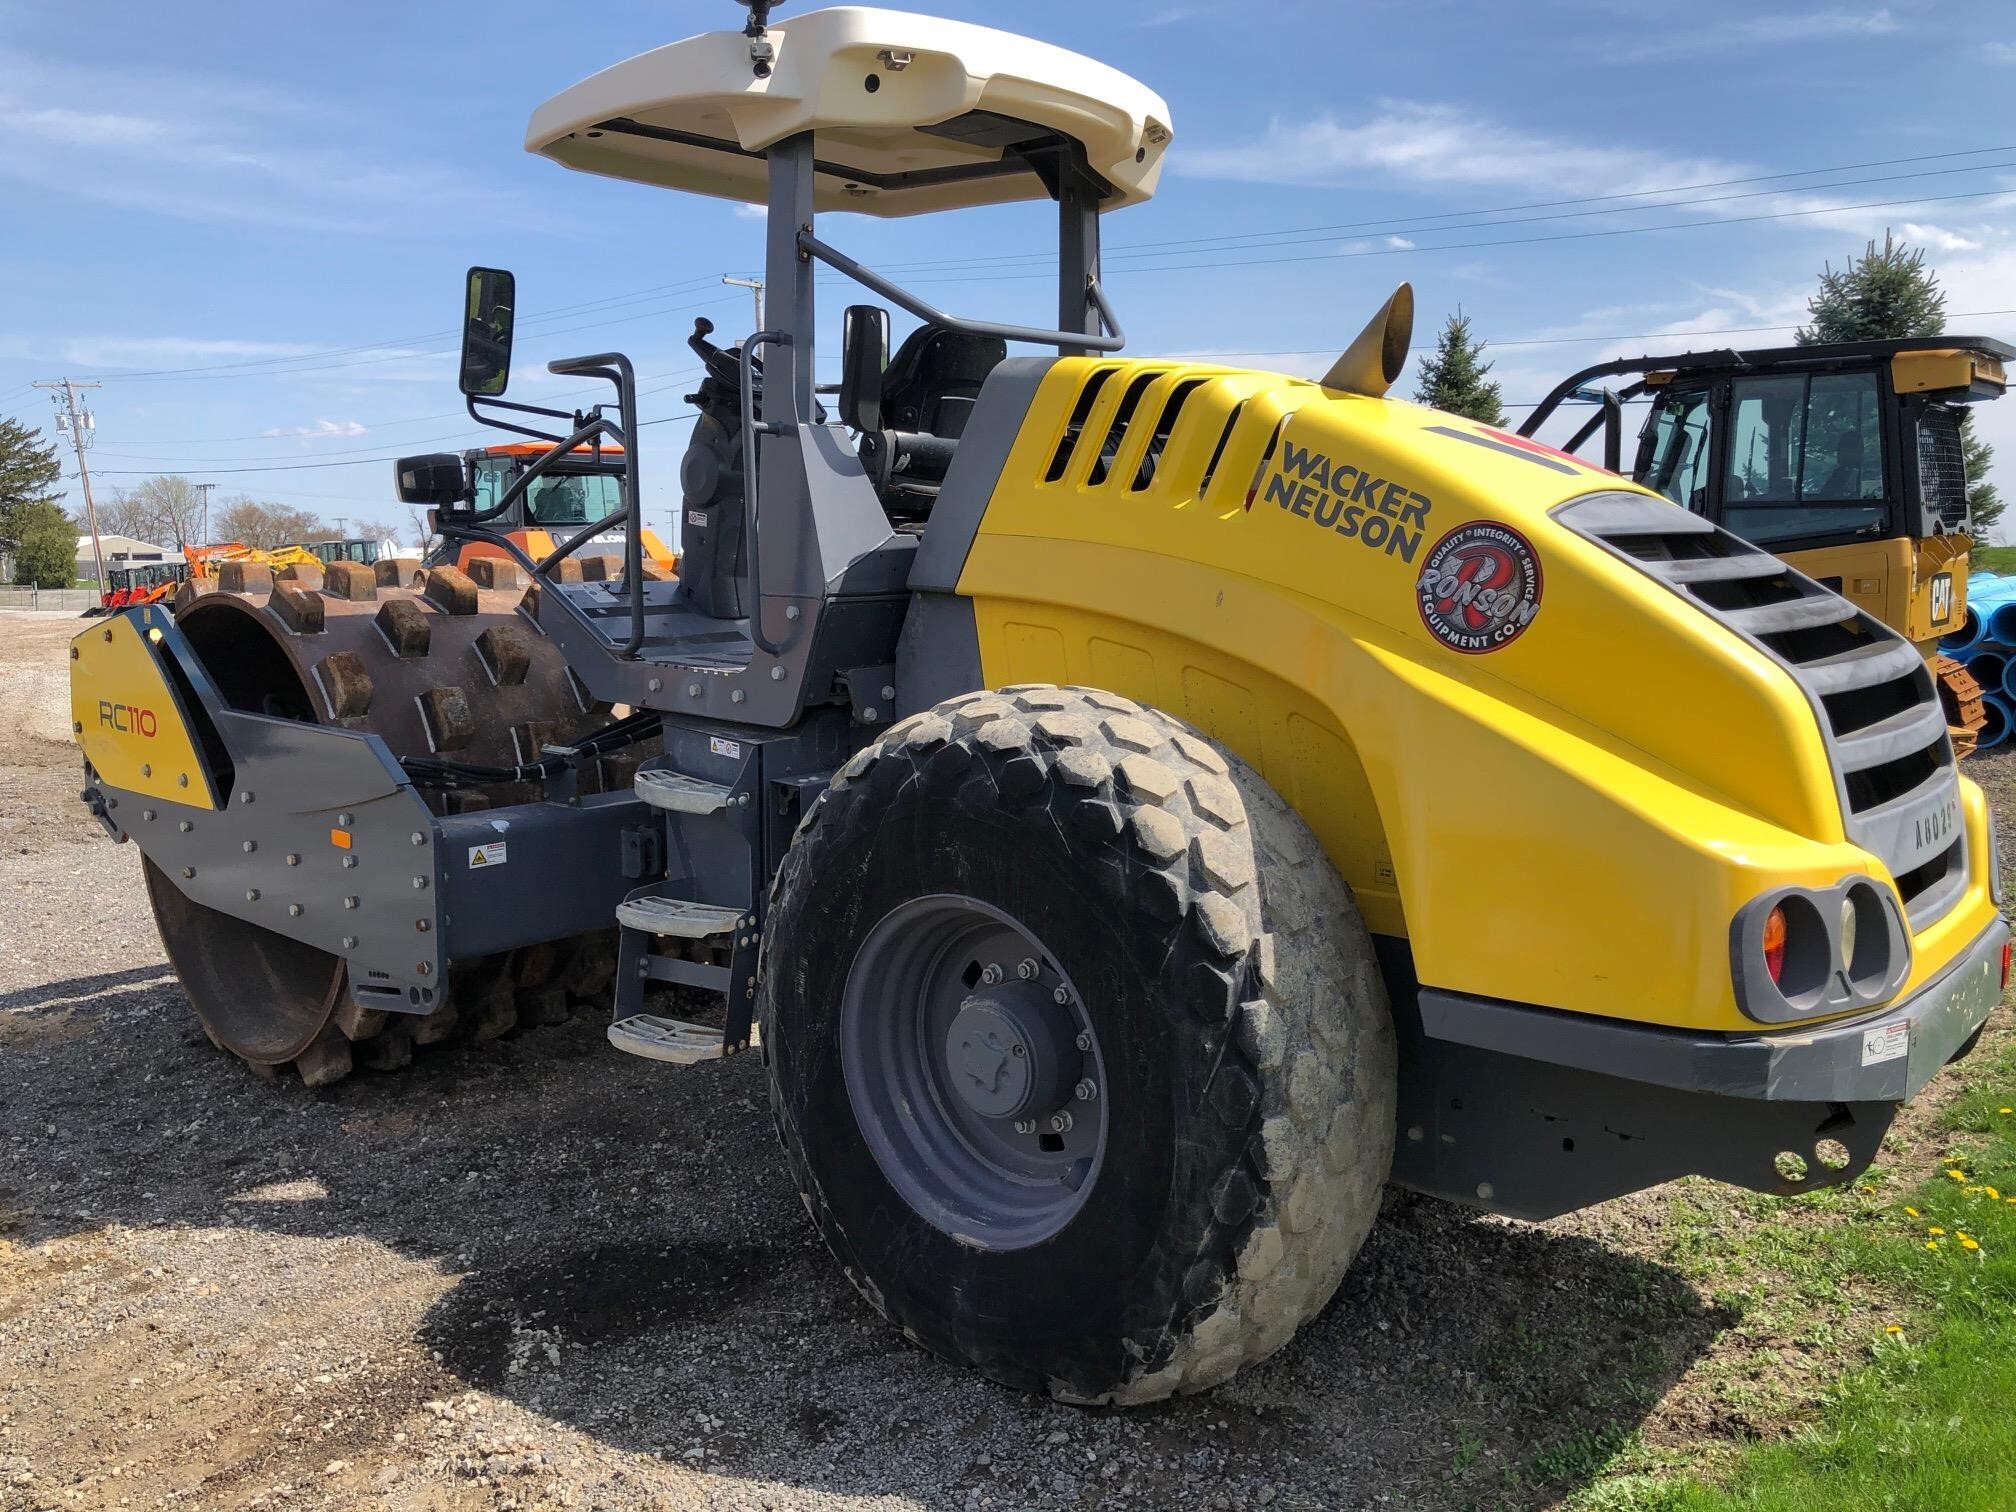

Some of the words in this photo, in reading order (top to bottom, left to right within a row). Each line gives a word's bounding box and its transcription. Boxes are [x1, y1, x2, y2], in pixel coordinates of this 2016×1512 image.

[1284, 440, 1432, 530] WACKER
[1264, 474, 1423, 564] NEUSON
[1430, 533, 1464, 567] QUALITY
[1473, 528, 1522, 552] INTEGRITY
[1521, 558, 1535, 600] SERVICE
[1415, 568, 1540, 626] RONSON
[1422, 593, 1488, 648] EQUIPMENT
[1494, 622, 1521, 642] CO.
[1932, 577, 1951, 622] CAT
[99, 701, 157, 738] RC110
